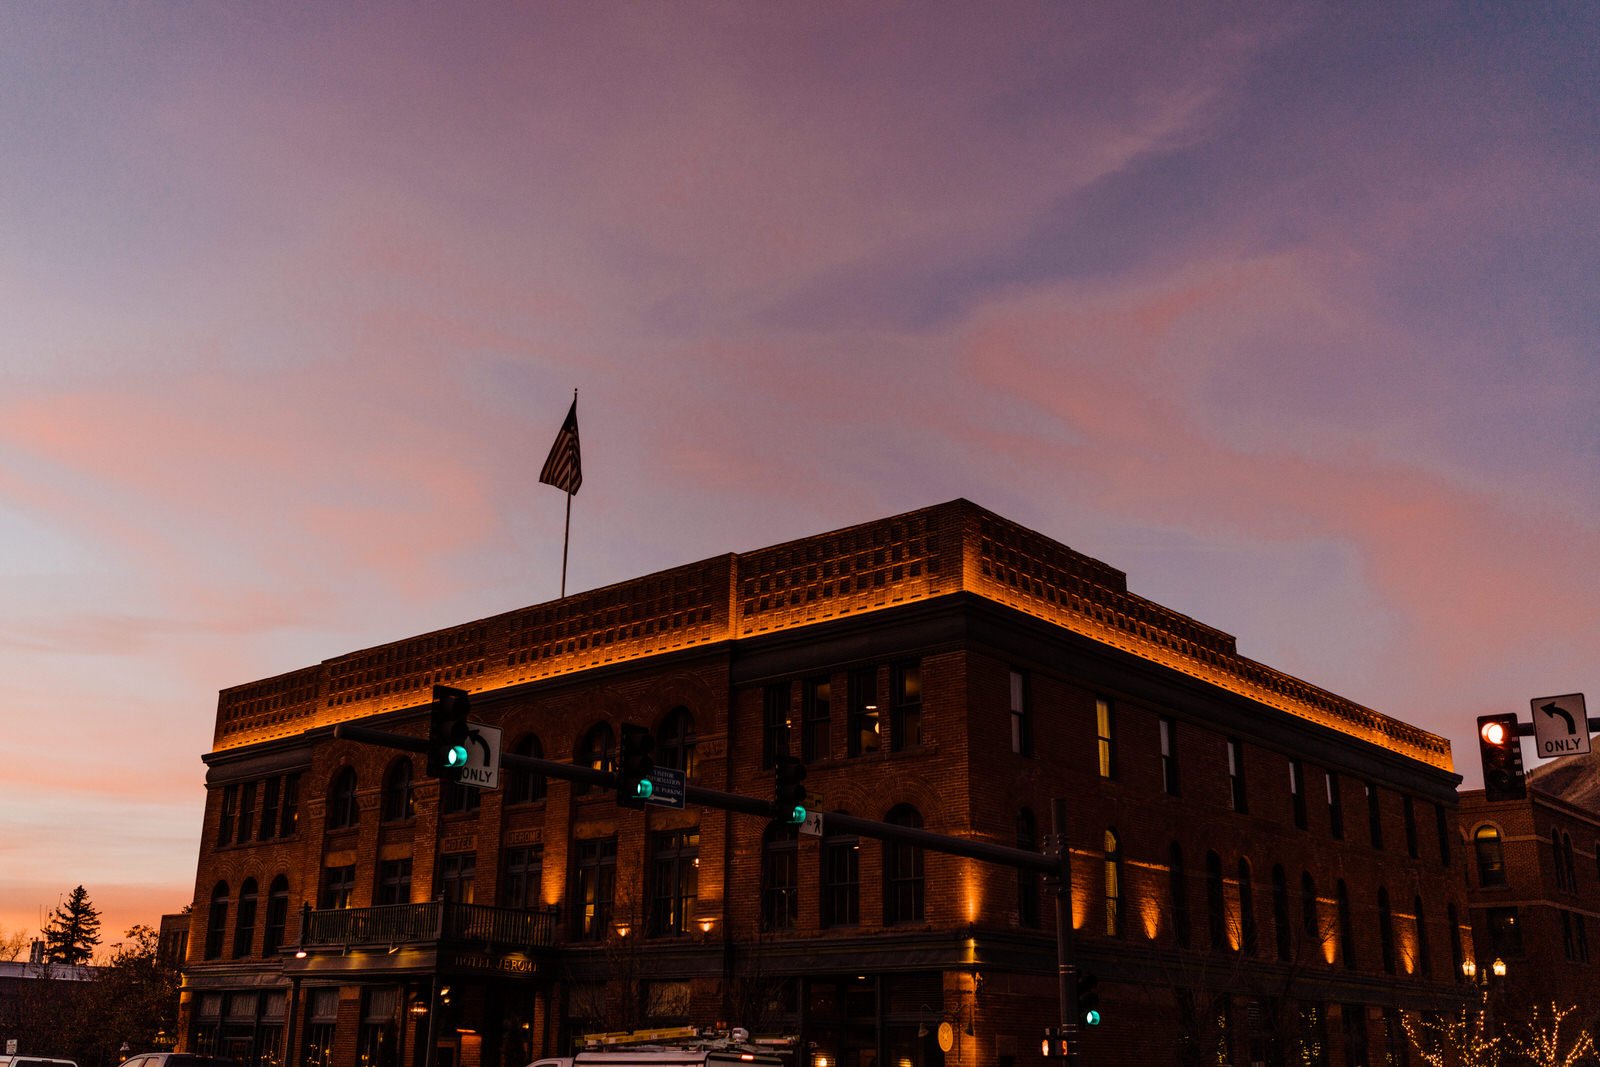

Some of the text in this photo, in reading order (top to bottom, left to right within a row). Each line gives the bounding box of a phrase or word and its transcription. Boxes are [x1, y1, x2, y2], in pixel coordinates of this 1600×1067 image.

[1545, 738, 1581, 753] ONLY
[462, 767, 493, 783] ONLY
[445, 830, 541, 850] HOTEL JEROME
